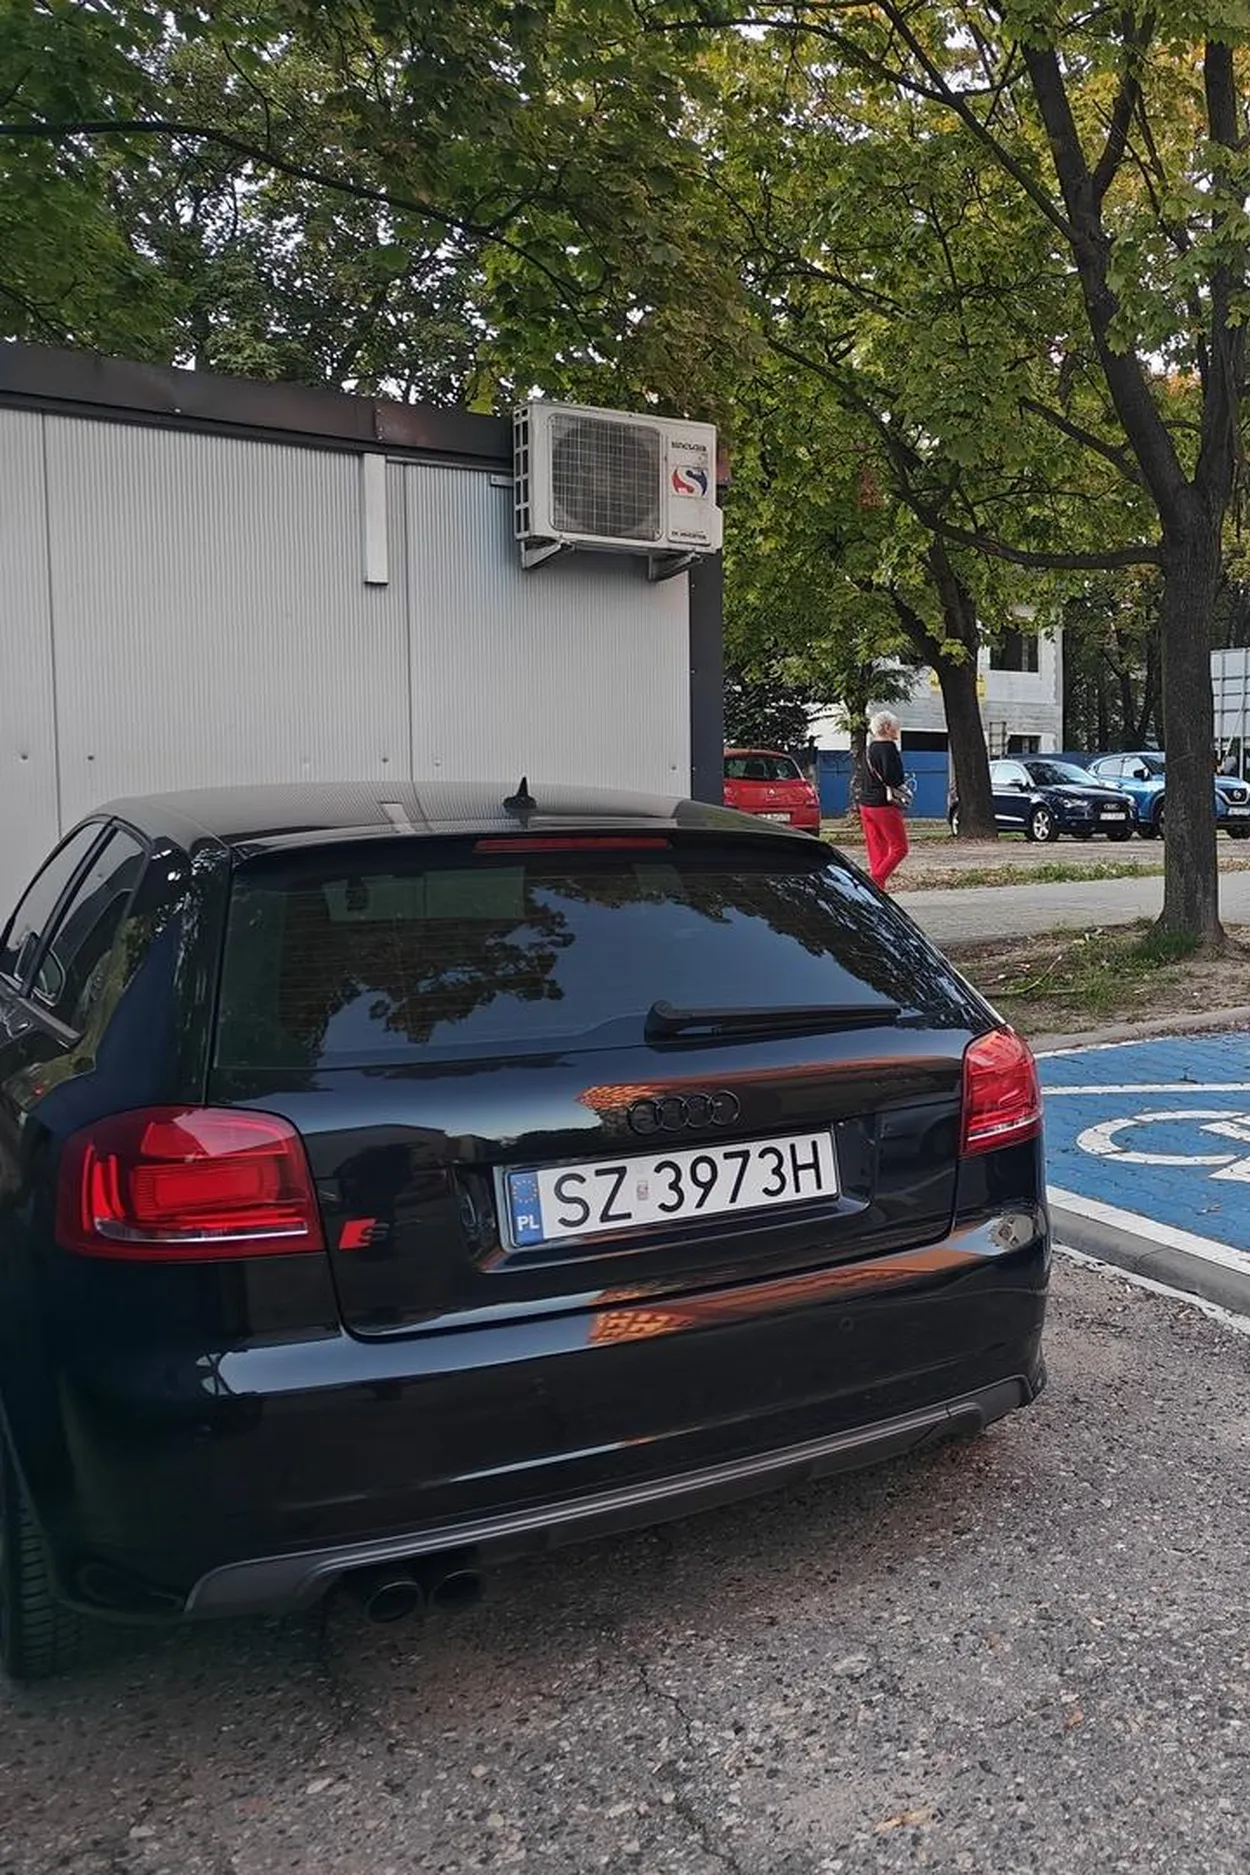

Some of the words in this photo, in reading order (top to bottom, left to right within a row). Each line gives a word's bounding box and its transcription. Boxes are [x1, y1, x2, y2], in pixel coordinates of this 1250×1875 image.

[554, 1166, 632, 1228] SZ
[654, 1139, 823, 1214] 3973H
[517, 1216, 540, 1231] PL
